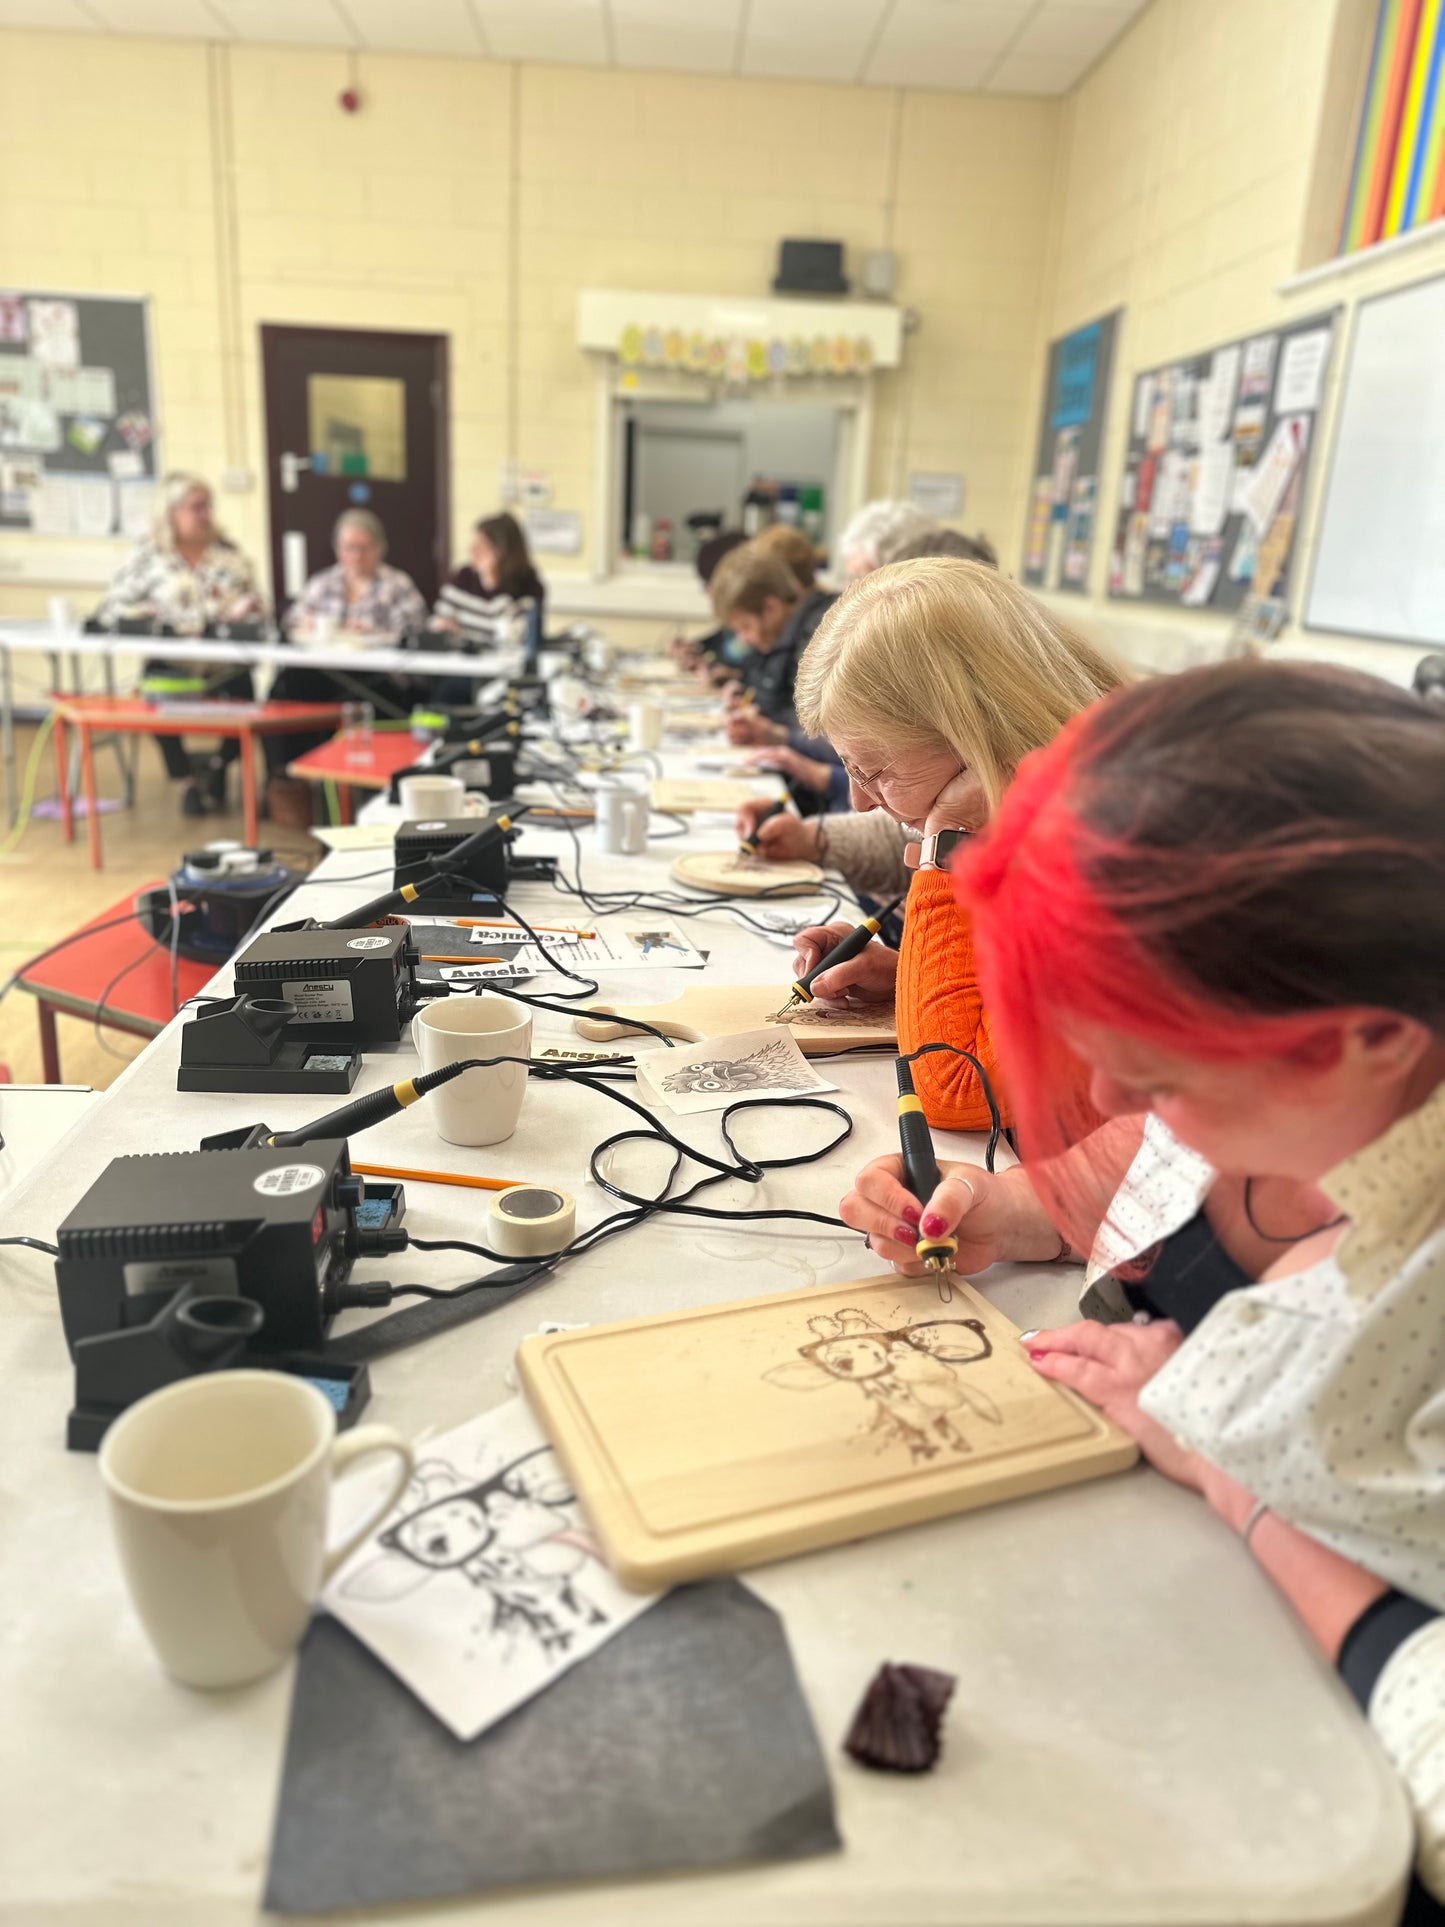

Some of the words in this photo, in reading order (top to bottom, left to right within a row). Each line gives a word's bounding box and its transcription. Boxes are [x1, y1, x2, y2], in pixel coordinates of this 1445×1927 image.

[450, 964, 530, 978] Angela
[303, 984, 334, 992] Anesty
[540, 1049, 624, 1060] Angel
